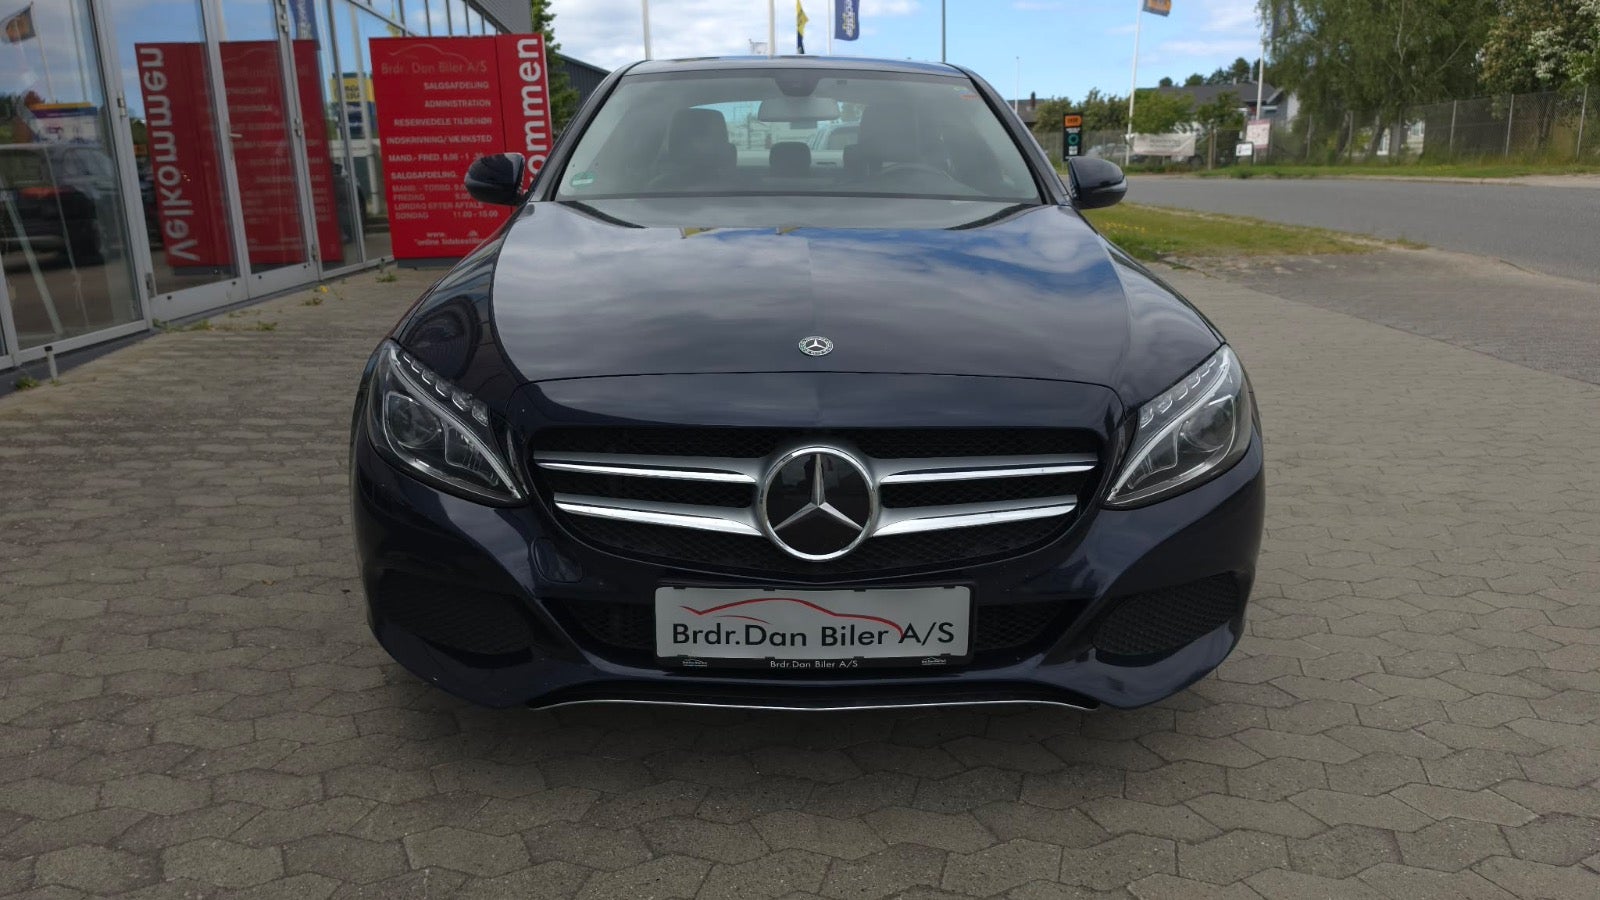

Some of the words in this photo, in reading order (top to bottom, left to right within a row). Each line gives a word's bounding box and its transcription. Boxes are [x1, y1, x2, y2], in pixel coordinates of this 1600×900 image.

[423, 81, 489, 90] SALGSAFDELING
[424, 99, 491, 108] ADMINISTRATION
[517, 38, 547, 183] ommen
[821, 626, 889, 647] Biler
[898, 622, 955, 646] A/S
[814, 660, 836, 669] Biler
[839, 659, 859, 669] A/S
